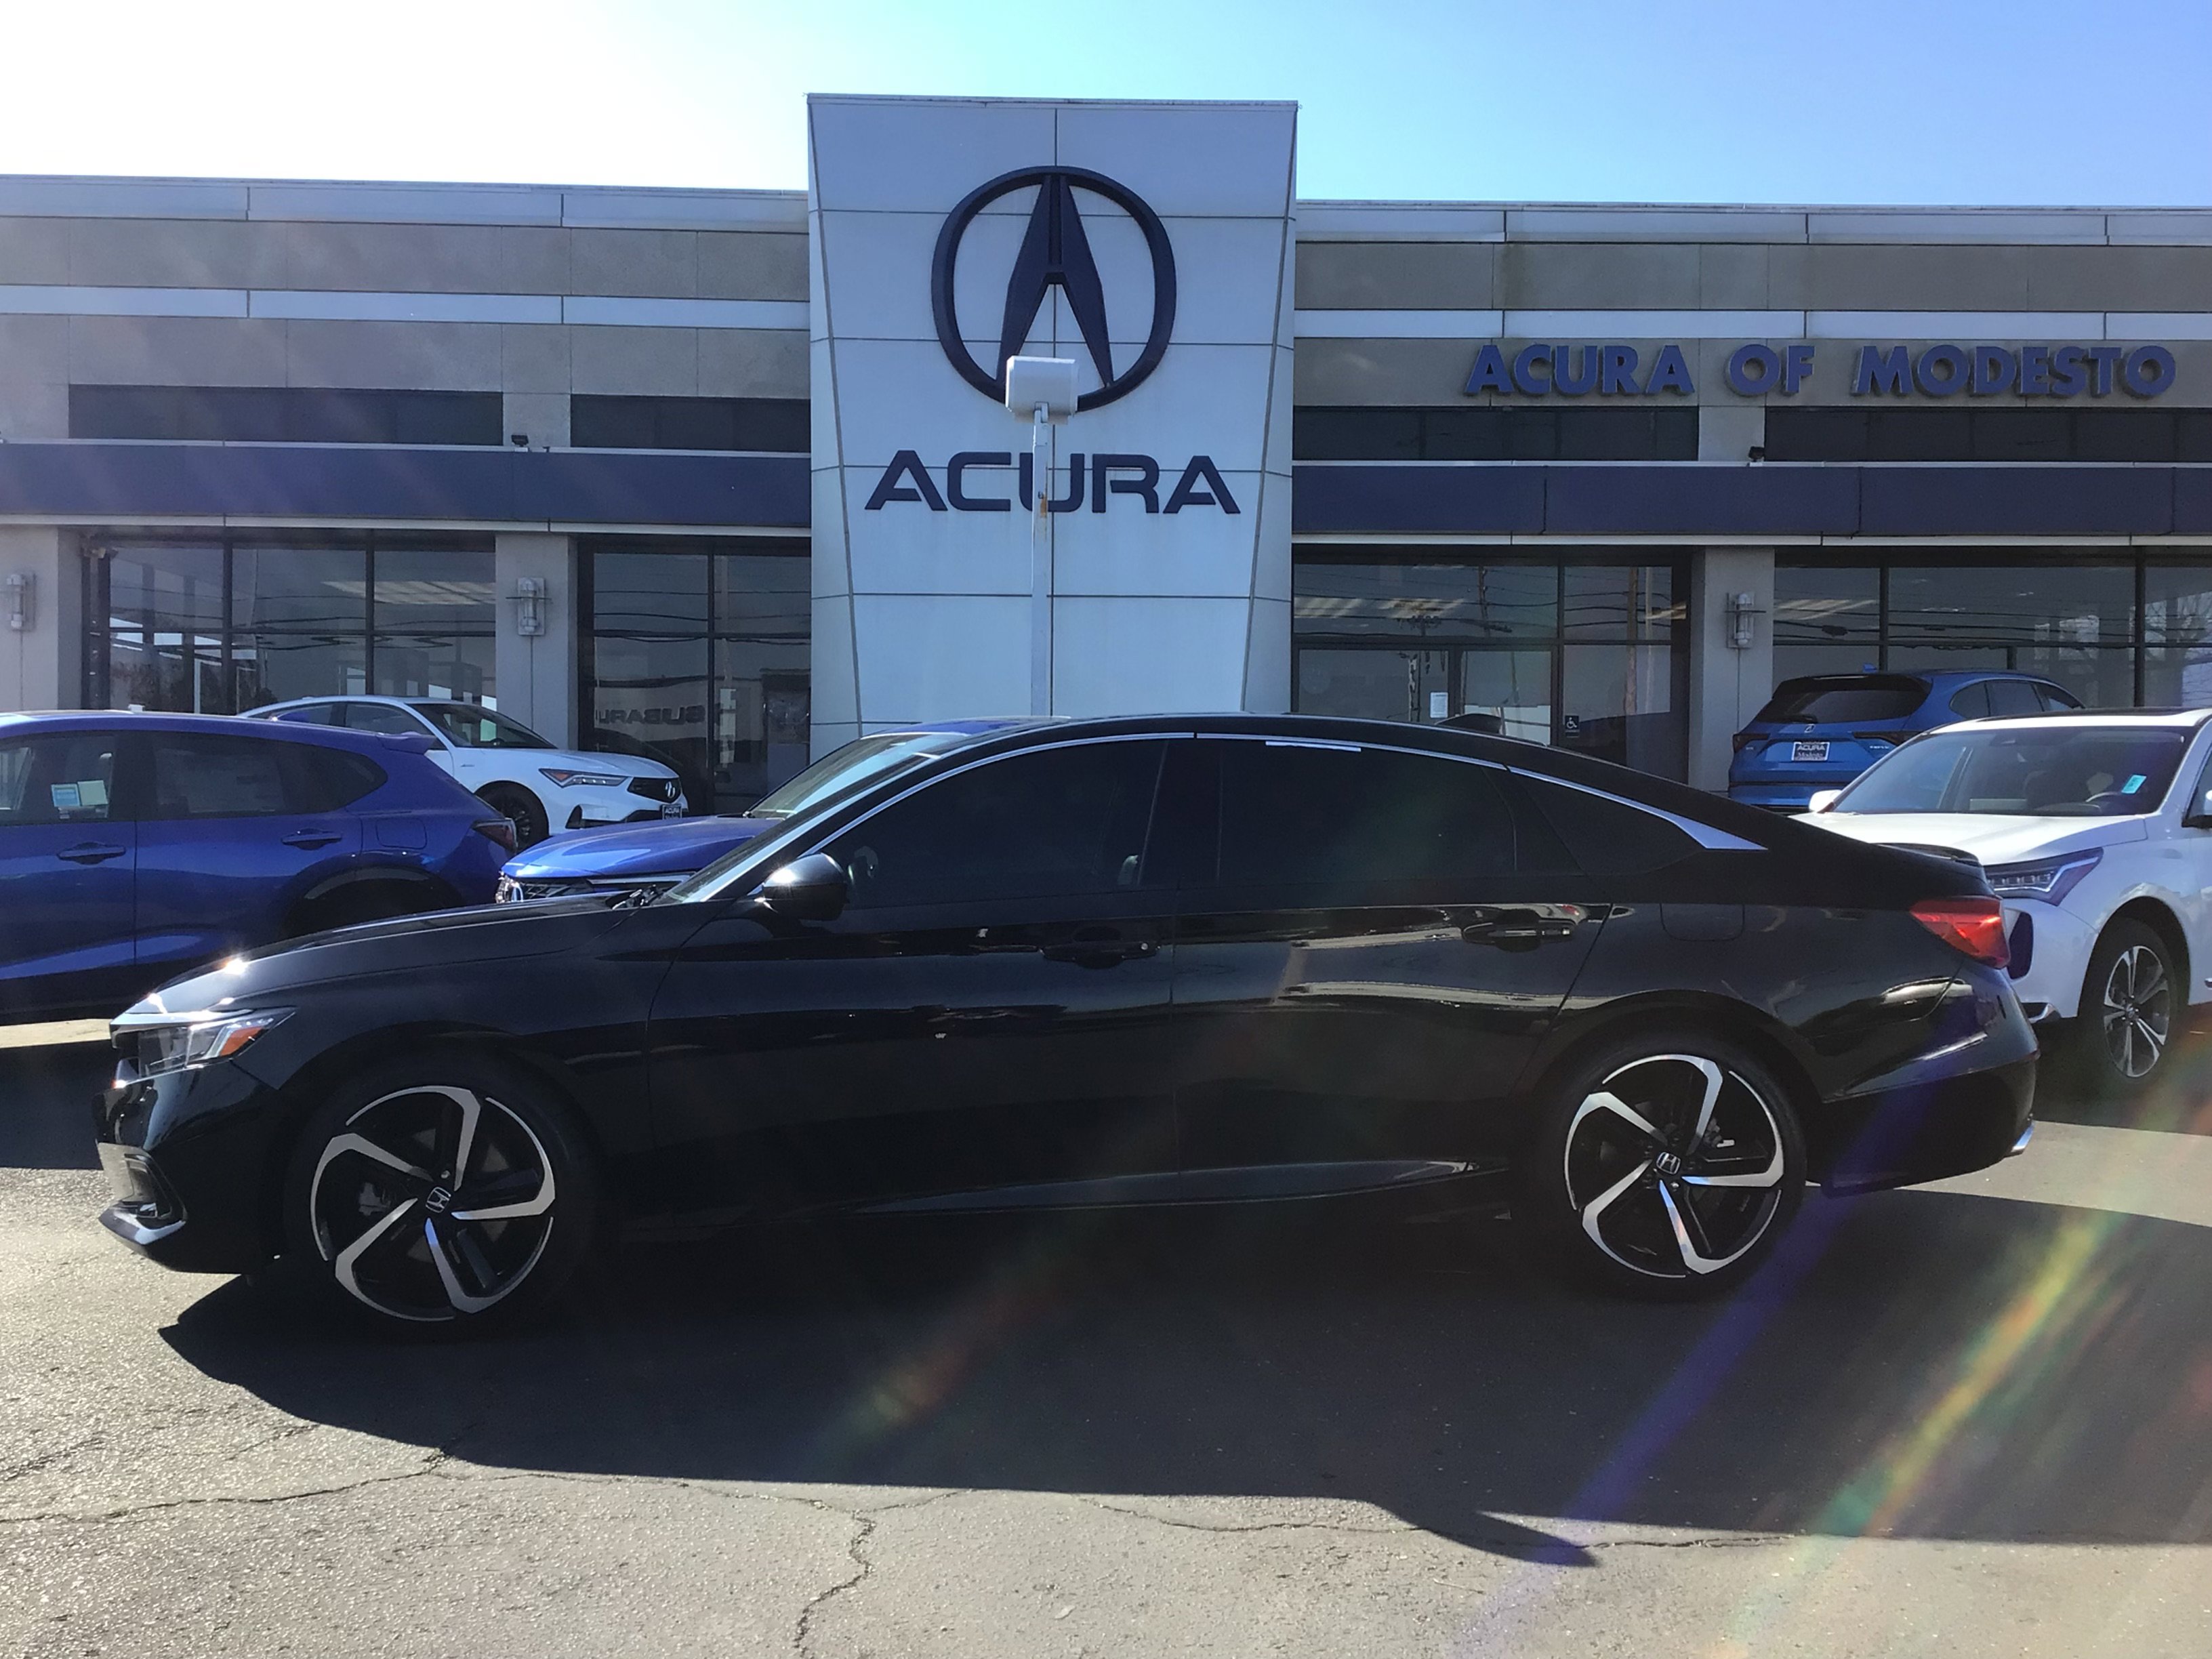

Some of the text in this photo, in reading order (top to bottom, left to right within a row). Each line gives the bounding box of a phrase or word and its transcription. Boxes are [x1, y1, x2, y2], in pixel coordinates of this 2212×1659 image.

[1465, 344, 2177, 397] ACURA OF MODESTO
[864, 450, 1241, 514] ACURA
